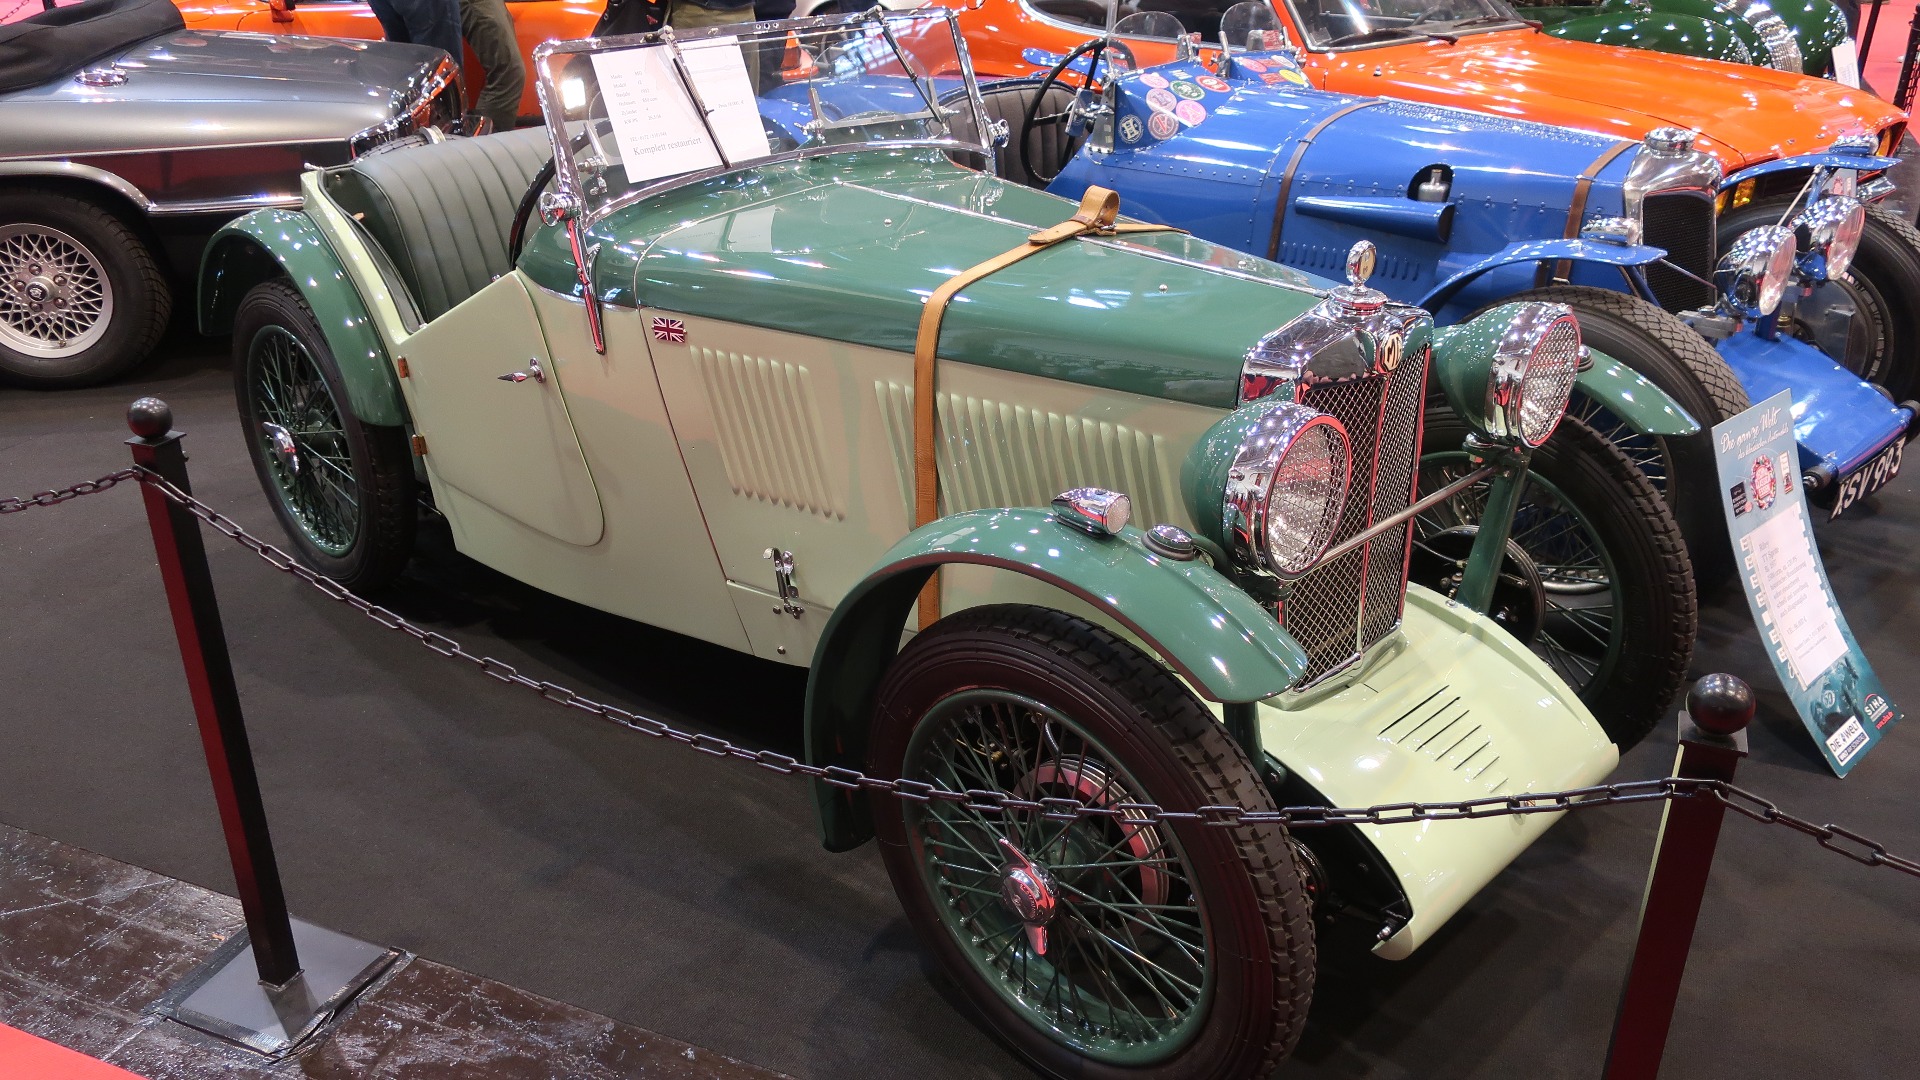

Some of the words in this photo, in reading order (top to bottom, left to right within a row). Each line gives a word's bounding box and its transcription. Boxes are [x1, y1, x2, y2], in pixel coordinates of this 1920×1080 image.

[633, 143, 667, 156] Komplett
[667, 137, 702, 150] restauriert
[1720, 430, 1736, 454] Die
[1760, 406, 1782, 431] Welt
[1864, 696, 1884, 715] SIHA
[1830, 737, 1842, 752] DIE
